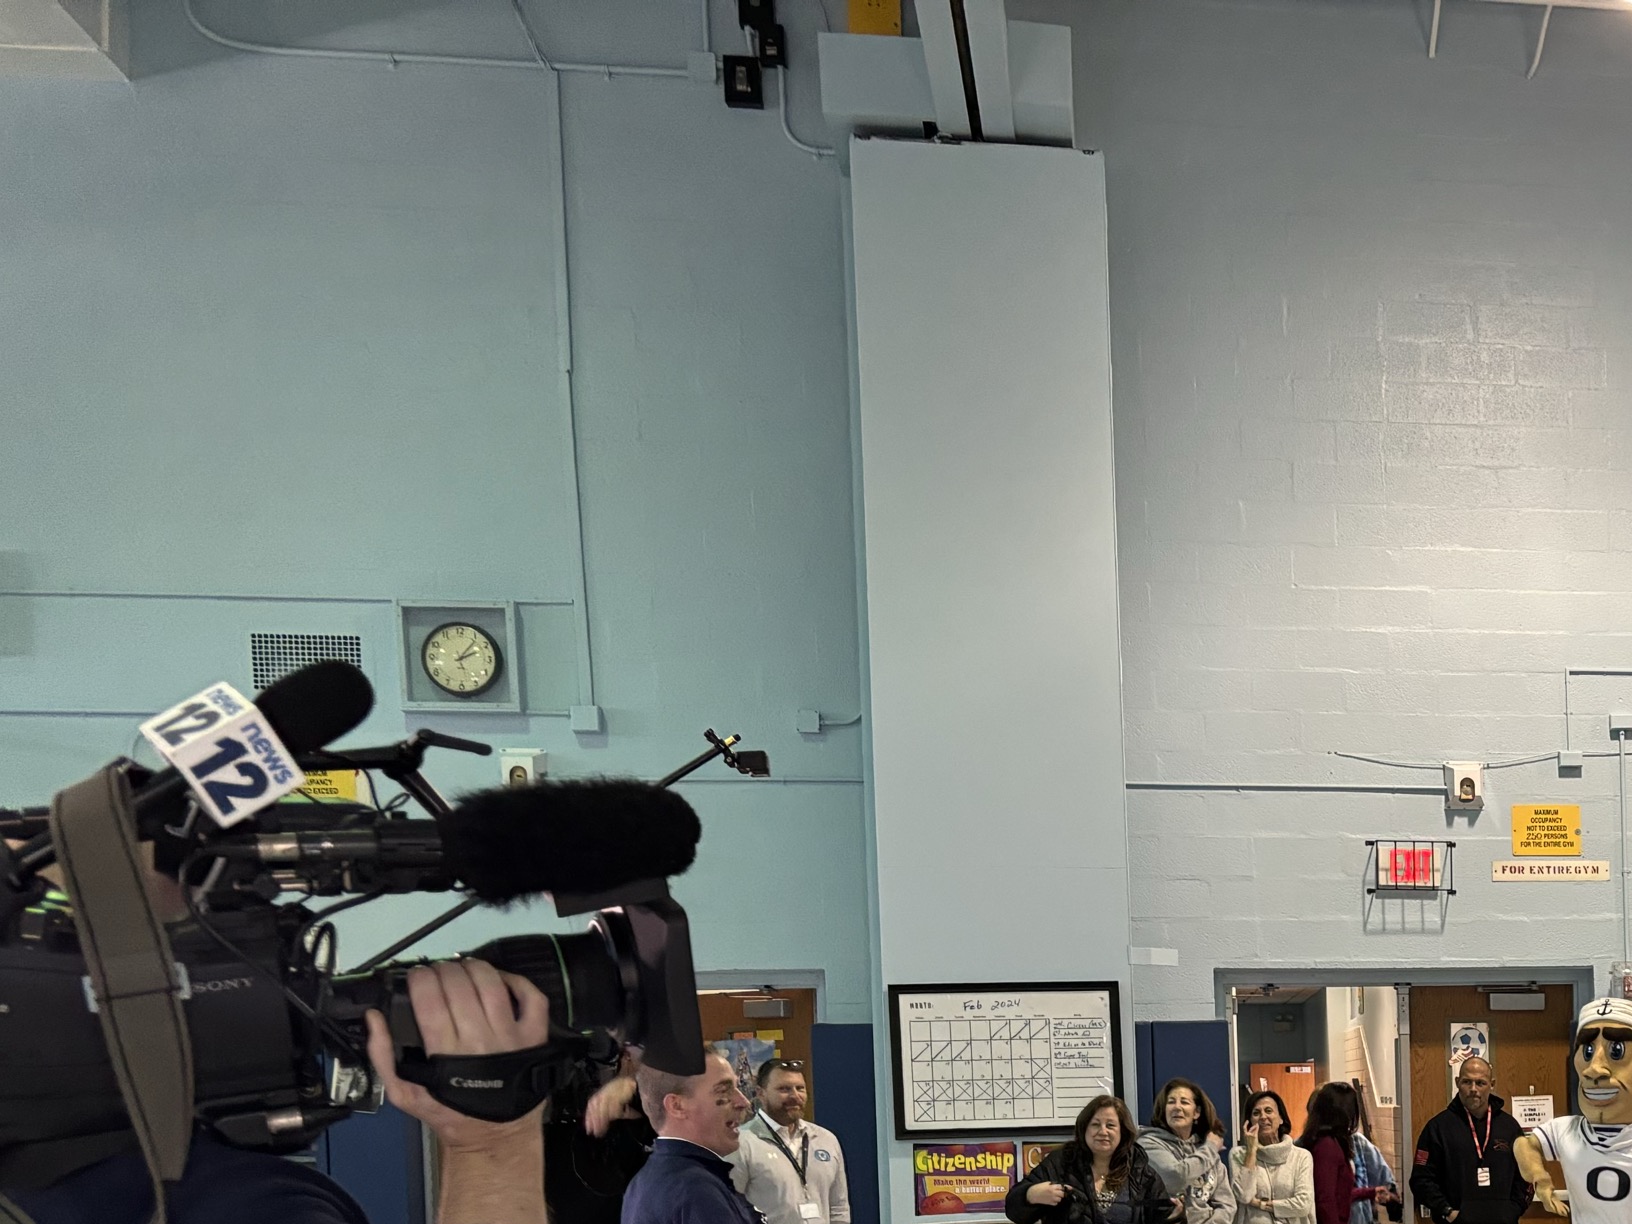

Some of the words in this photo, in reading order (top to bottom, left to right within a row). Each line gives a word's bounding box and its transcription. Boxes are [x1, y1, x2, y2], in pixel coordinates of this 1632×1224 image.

[153, 702, 221, 746] 12
[240, 721, 294, 785] news
[189, 736, 269, 816] 12
[1390, 848, 1433, 884] EXIT
[1501, 865, 1525, 875] FOR
[963, 1000, 983, 1012] Feb
[990, 998, 1021, 1011] 2024
[449, 1077, 504, 1089] Canon
[915, 1150, 1015, 1174] Citizenship
[1586, 1166, 1631, 1201] O
